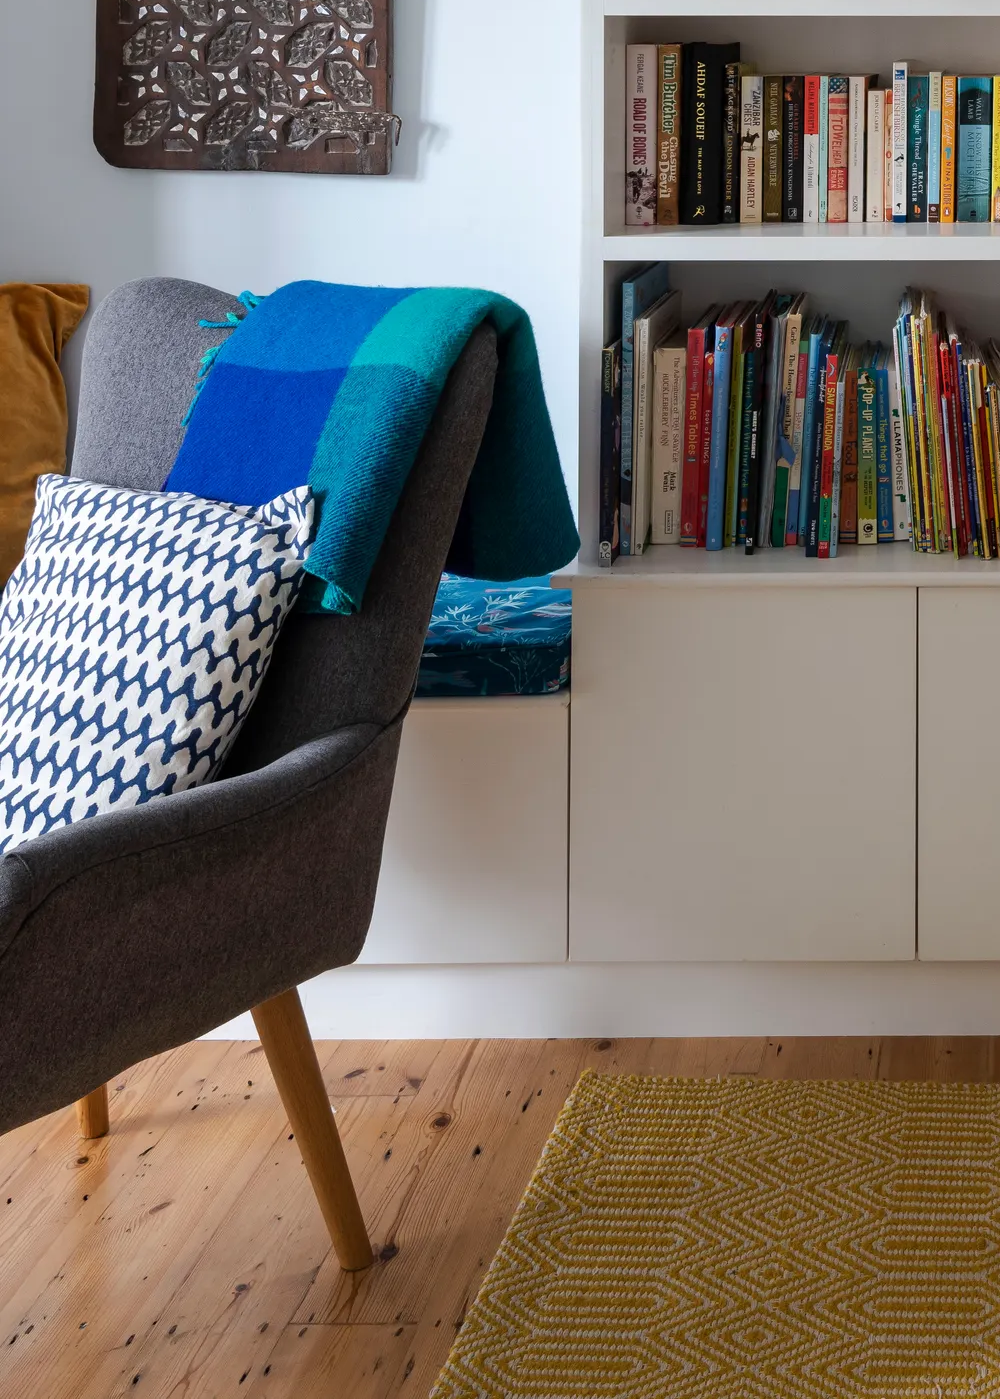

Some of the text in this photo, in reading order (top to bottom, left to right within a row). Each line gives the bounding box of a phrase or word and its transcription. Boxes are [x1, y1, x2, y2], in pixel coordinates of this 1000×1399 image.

[662, 54, 677, 134] Tim Butcher
[696, 61, 705, 140] AHDAF SOUEIF
[743, 103, 751, 126] CHEST
[633, 98, 646, 165] ROAD OF BONES
[831, 117, 844, 164] TOWELHEAD
[659, 141, 671, 199] the Devil
[668, 136, 678, 183] Chasing
[789, 326, 798, 345] Carle
[687, 392, 699, 455] Times Tables
[861, 387, 874, 424] POP-UP
[893, 421, 904, 491] LLAMAPHONES
[662, 471, 671, 493] Twain
[669, 471, 677, 492] Mark
